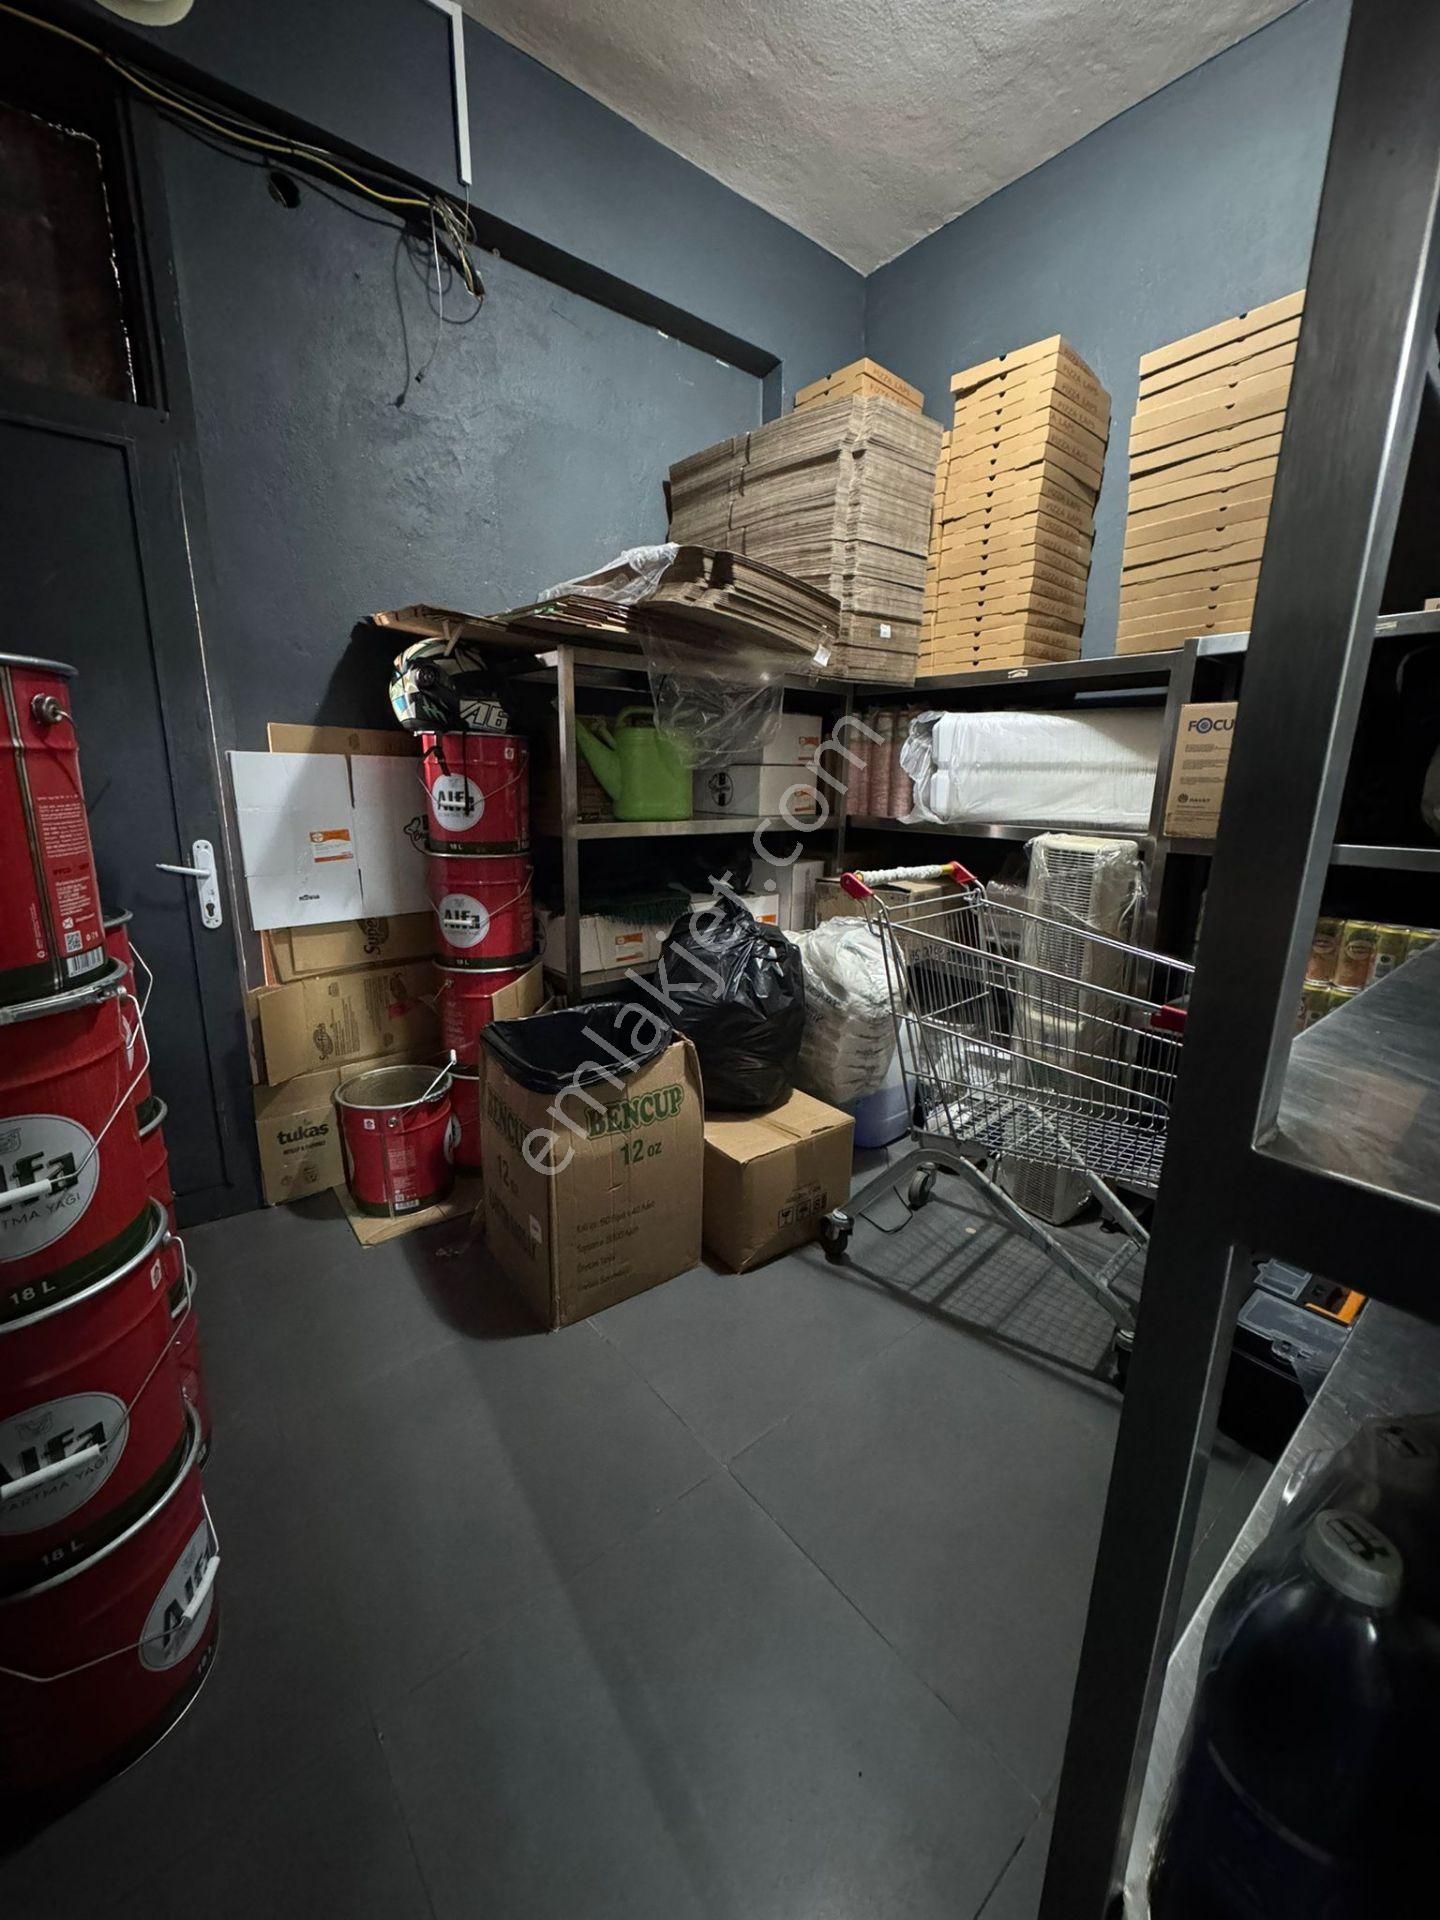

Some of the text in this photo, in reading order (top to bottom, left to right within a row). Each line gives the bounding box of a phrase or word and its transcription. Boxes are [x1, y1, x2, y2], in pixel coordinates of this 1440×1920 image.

[1187, 717, 1234, 734] FOCU
[363, 916, 381, 956] Supe
[586, 1085, 684, 1141] BENCUP
[621, 1138, 662, 1166] 12 oz
[9, 1280, 57, 1305] 18 L
[42, 1552, 65, 1567] 18
